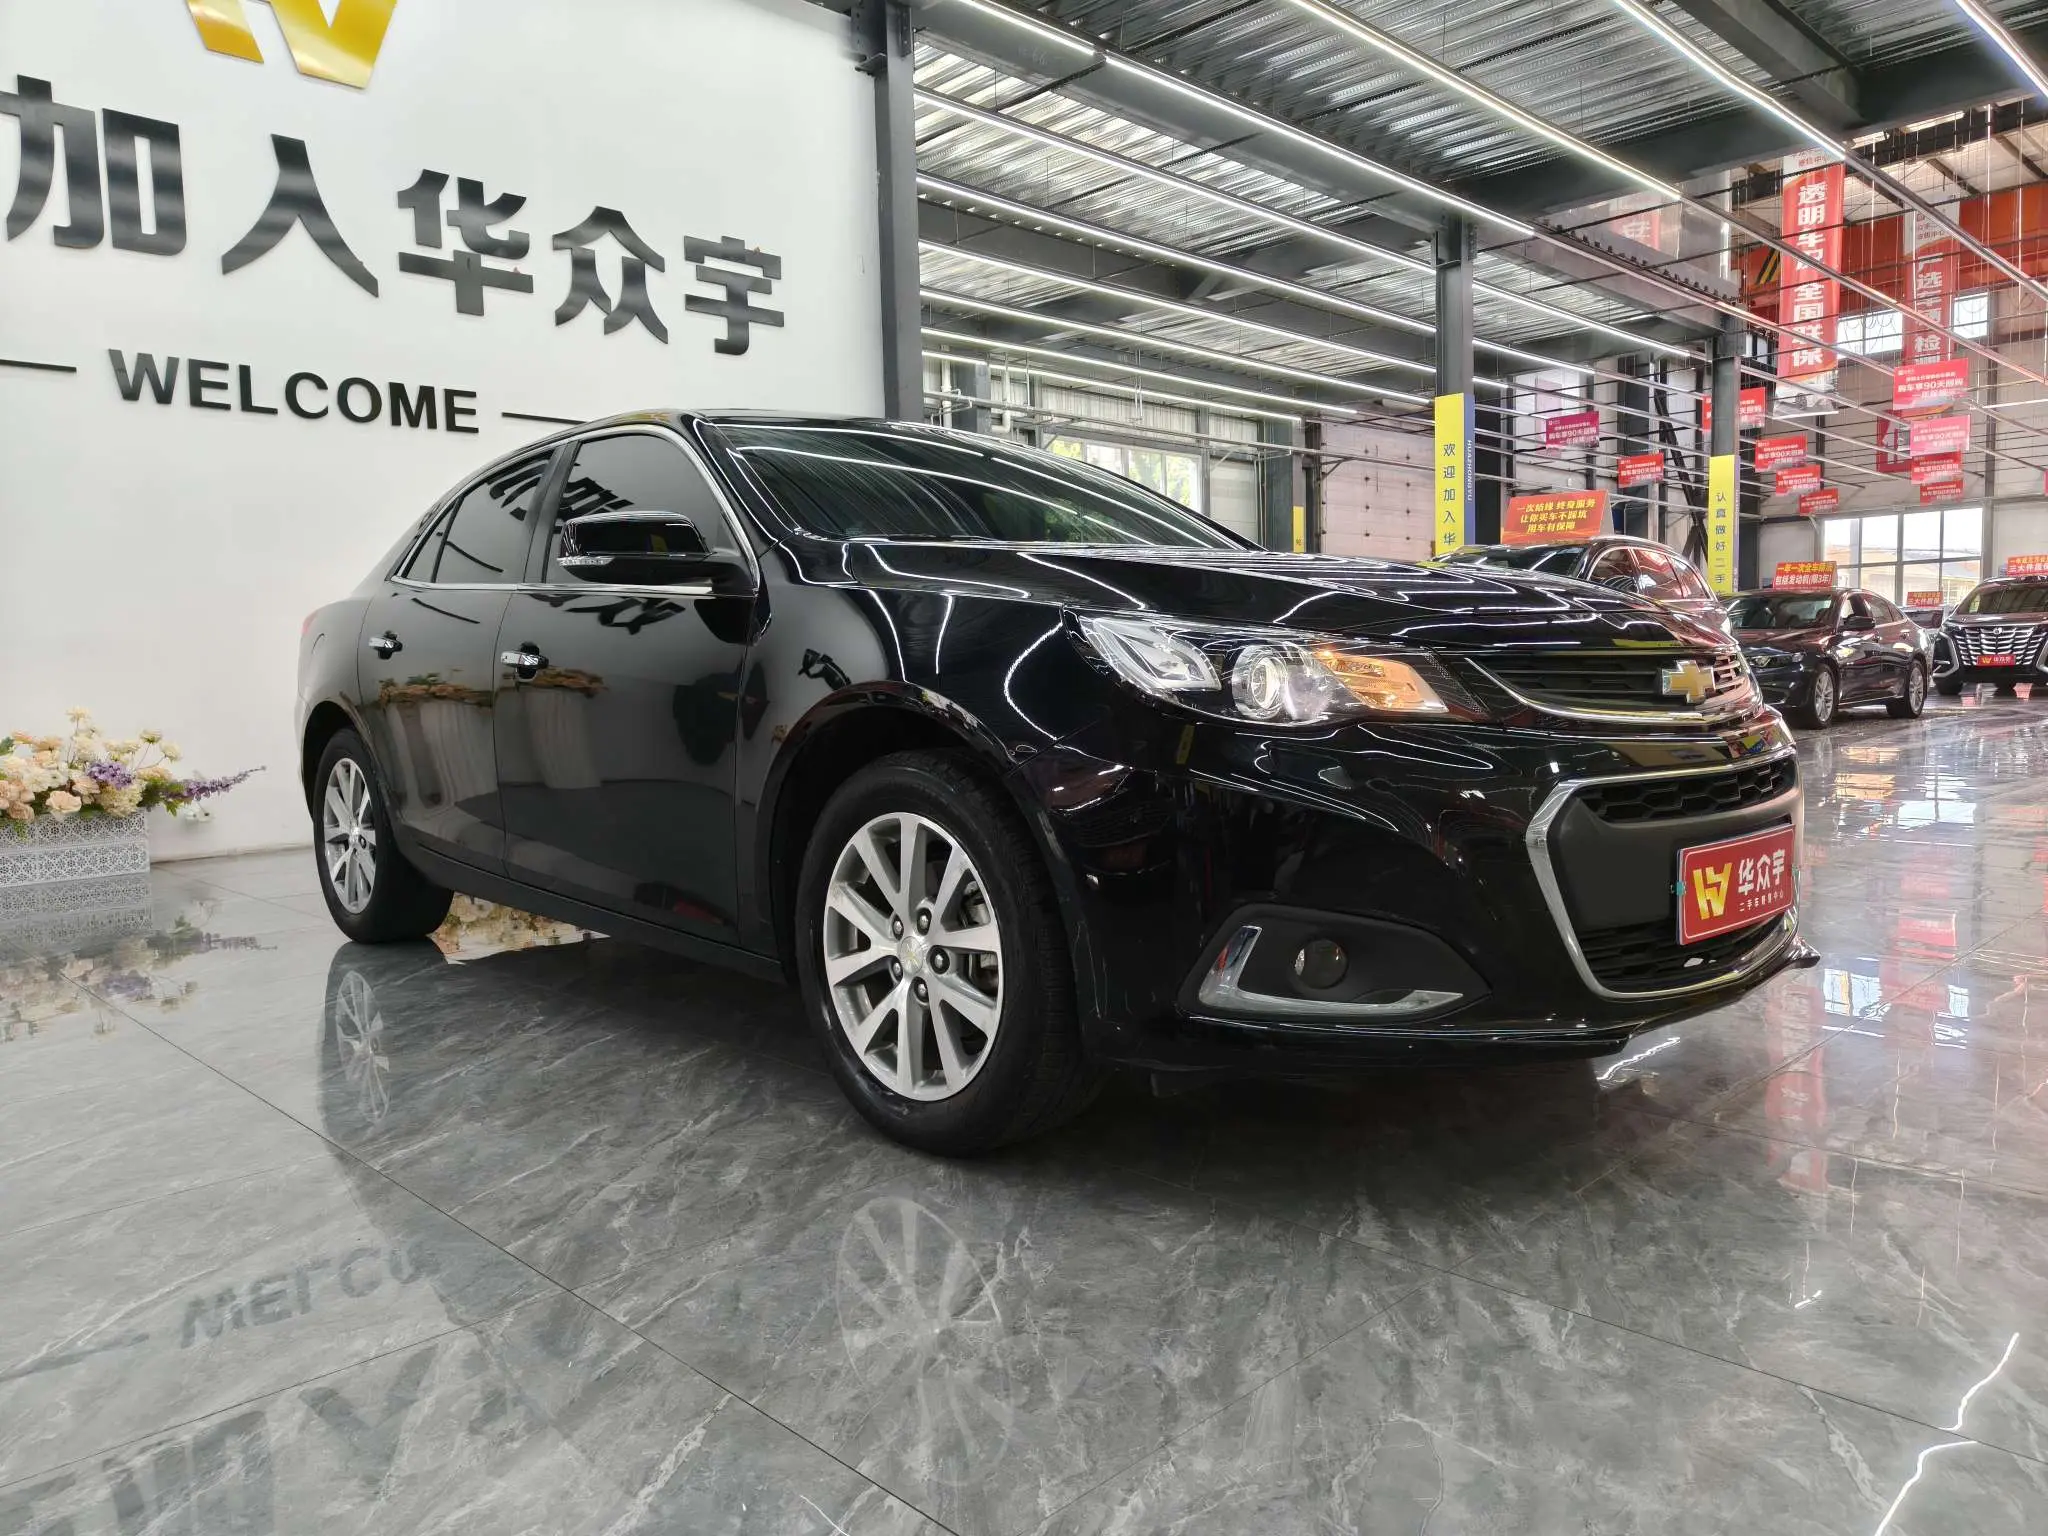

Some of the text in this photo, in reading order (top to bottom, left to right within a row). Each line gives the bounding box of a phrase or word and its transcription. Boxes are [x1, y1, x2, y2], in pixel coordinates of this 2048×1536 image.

[0, 74, 785, 356] 加入华众宇
[107, 348, 480, 434] WELCOME
[1443, 443, 1456, 545] 欢迎加入华
[1520, 509, 1588, 523] 让你买车不踩坑
[1527, 521, 1576, 534] 用车有保障
[1738, 849, 1785, 896] 华众宇
